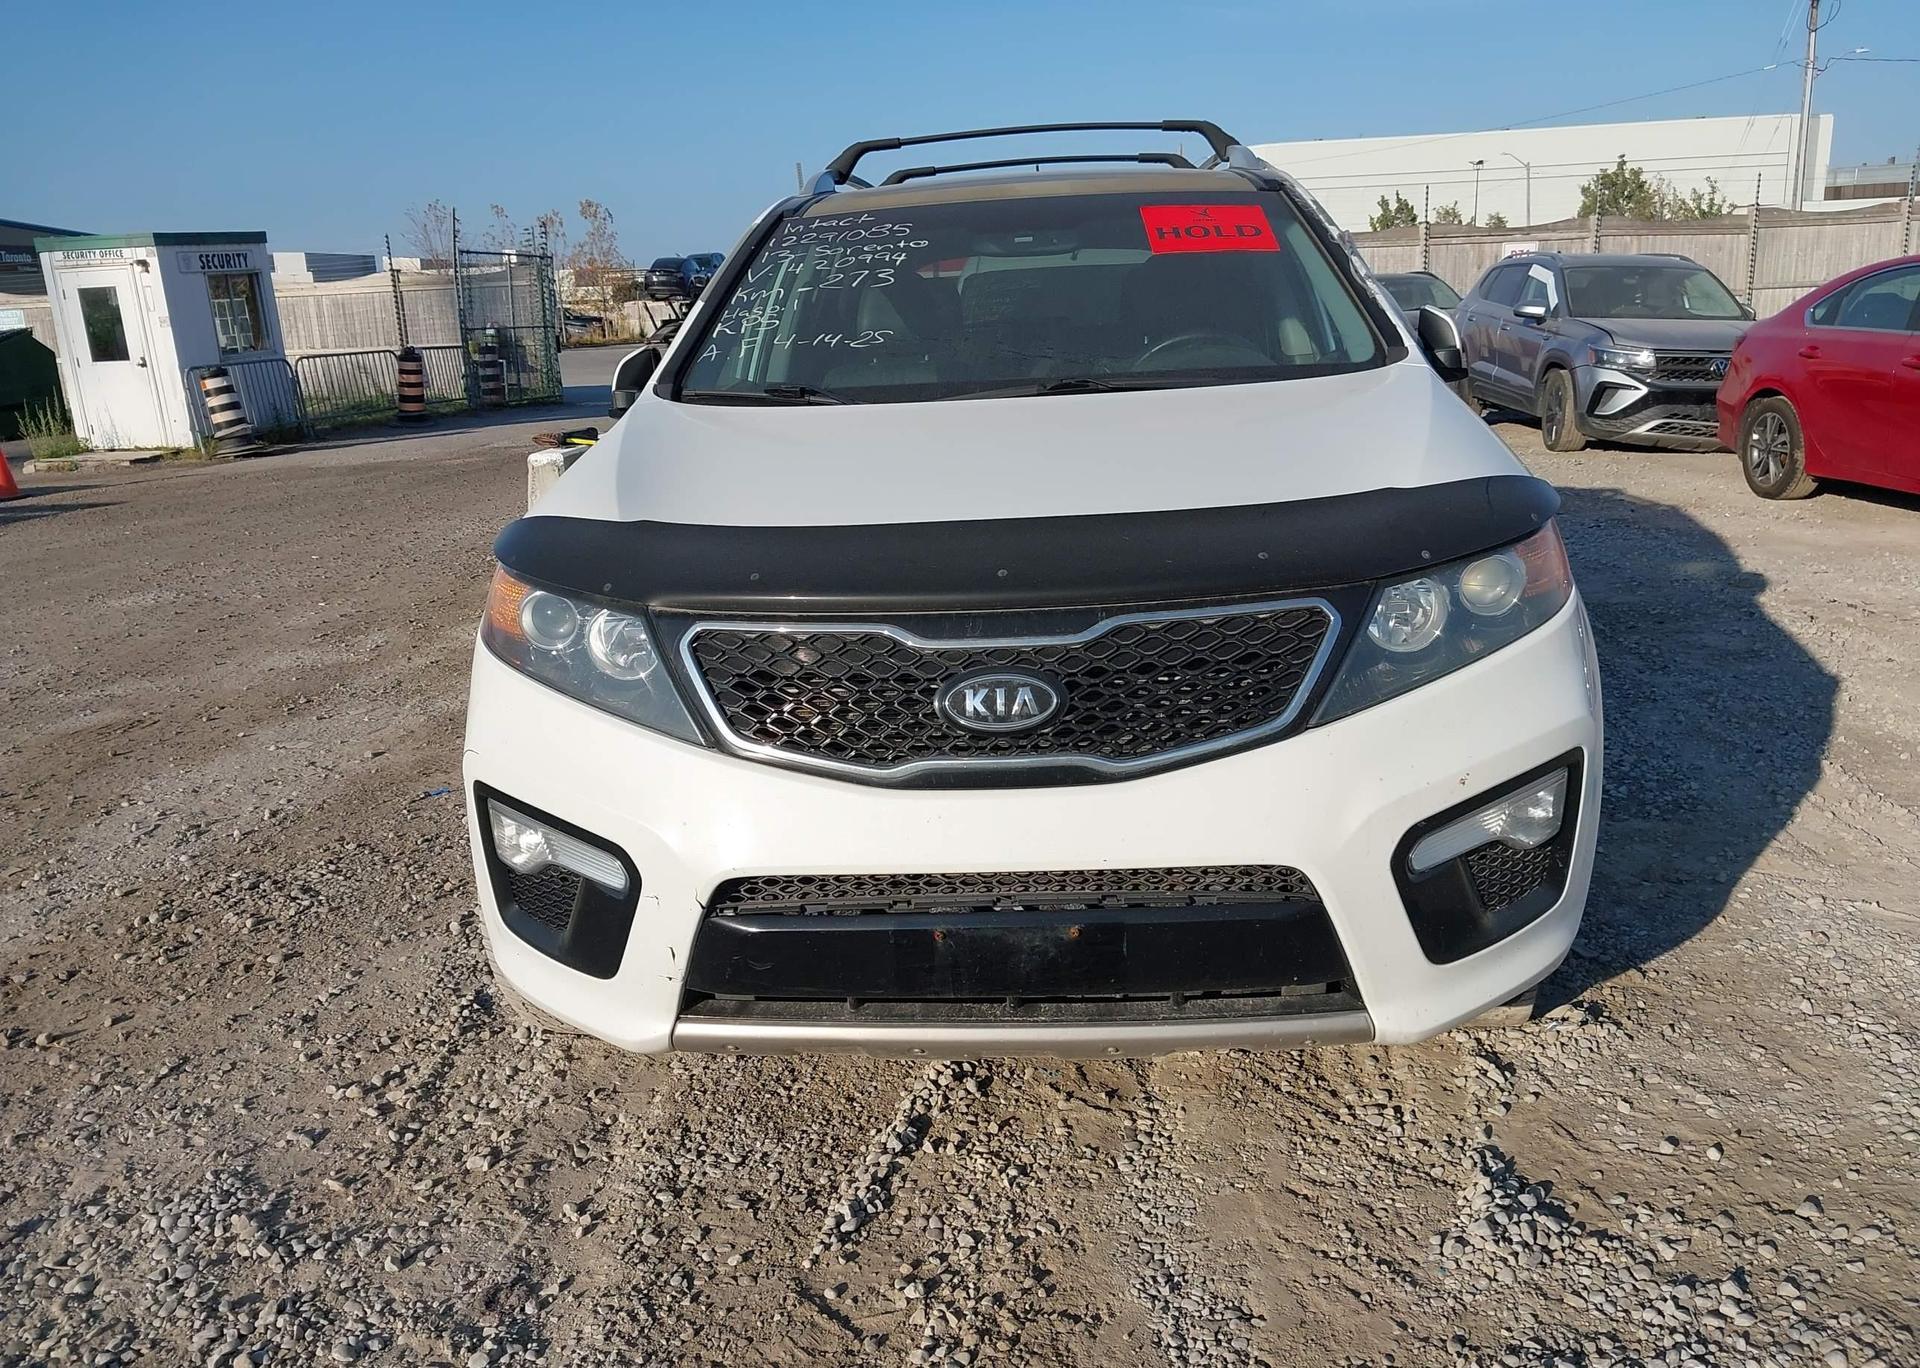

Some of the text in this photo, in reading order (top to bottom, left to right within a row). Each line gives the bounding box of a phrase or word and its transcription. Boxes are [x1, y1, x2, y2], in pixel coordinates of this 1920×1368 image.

[1155, 224, 1263, 241] HOLD
[62, 249, 124, 260] SECURITY OFFICE
[199, 252, 249, 270] SECURITY
[963, 686, 1040, 717] KIA
